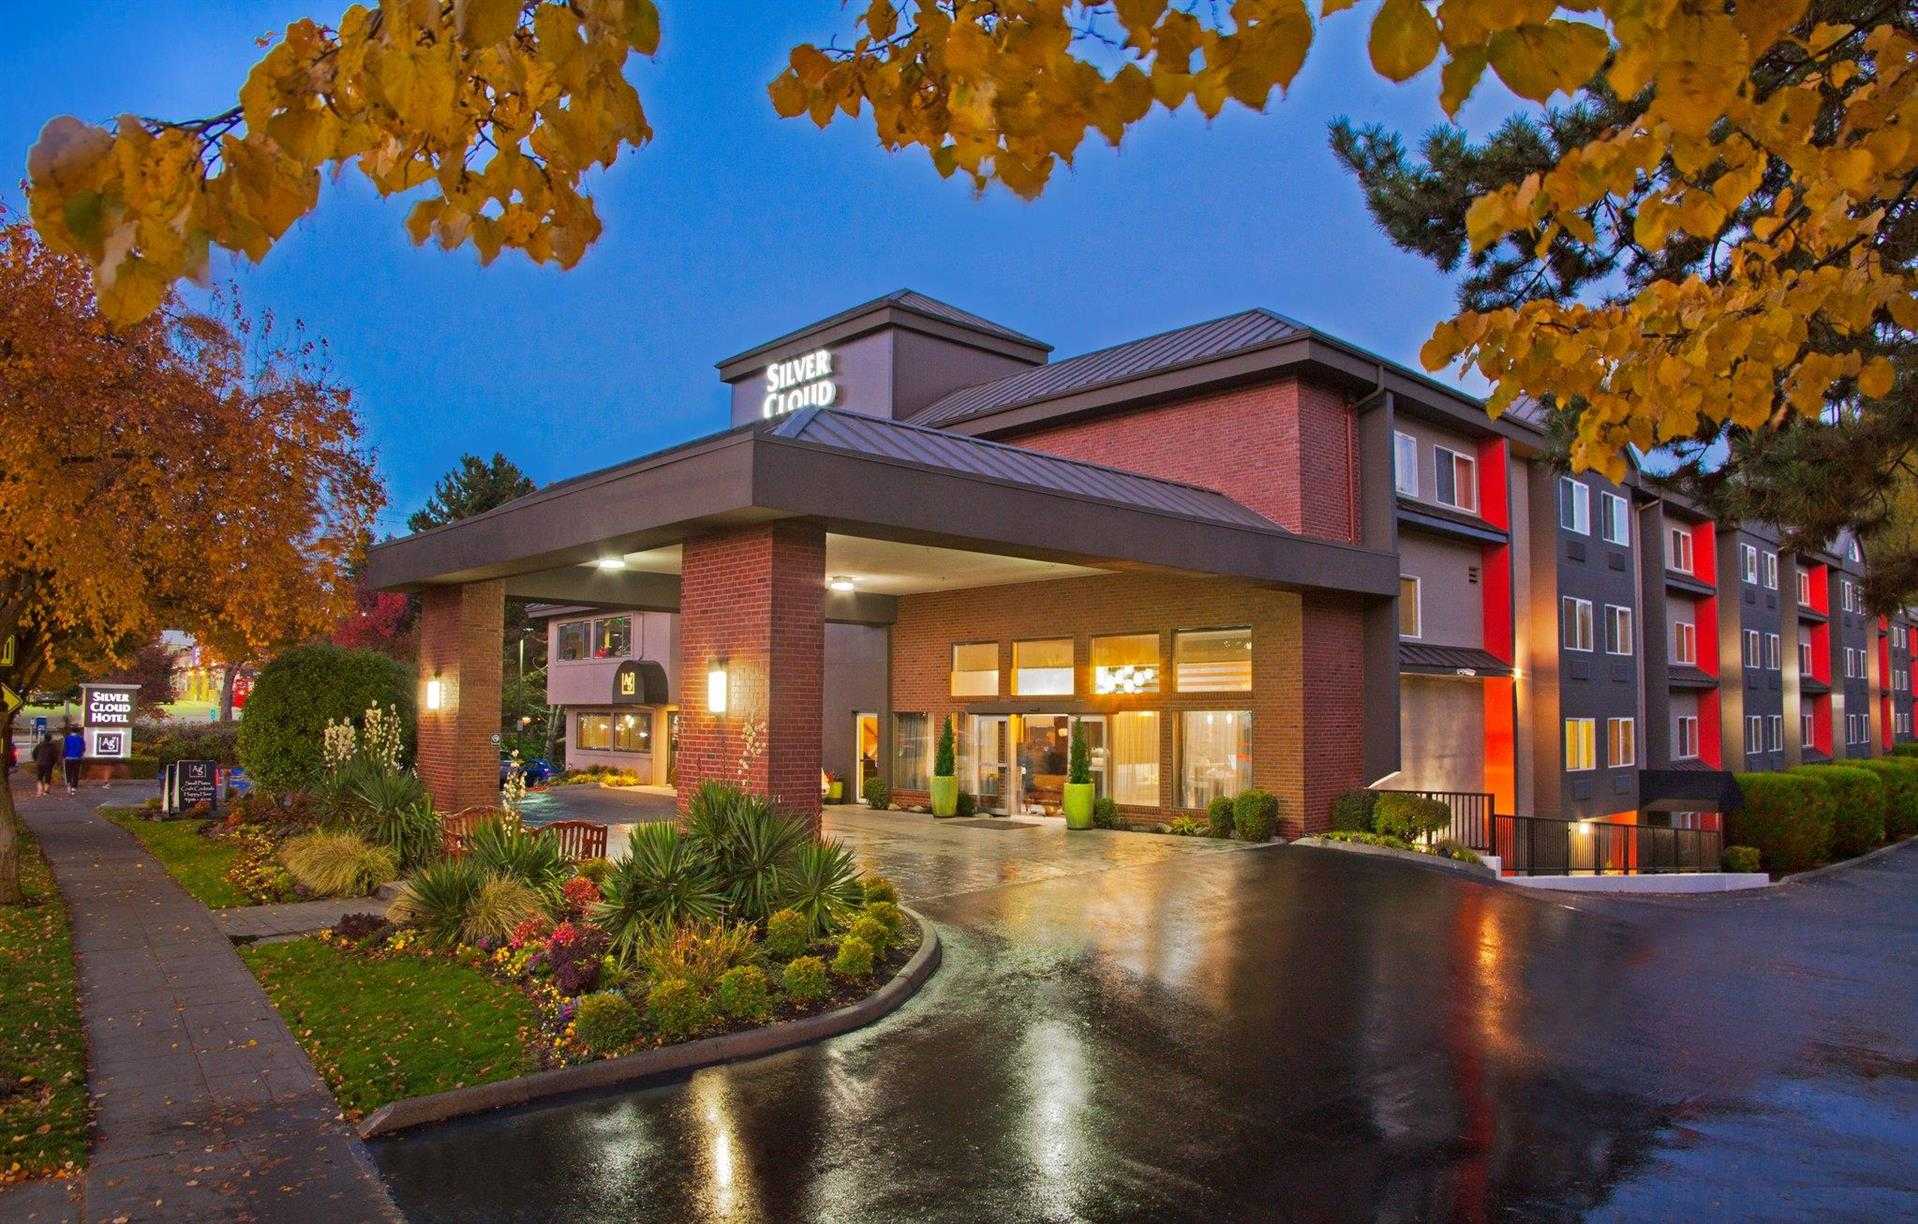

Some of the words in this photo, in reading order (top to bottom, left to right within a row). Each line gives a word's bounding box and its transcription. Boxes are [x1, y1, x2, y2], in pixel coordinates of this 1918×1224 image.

[766, 349, 833, 393] SILVER
[92, 691, 130, 702] SILVER
[90, 702, 131, 713] CLOUD
[91, 712, 129, 723] HOTEL
